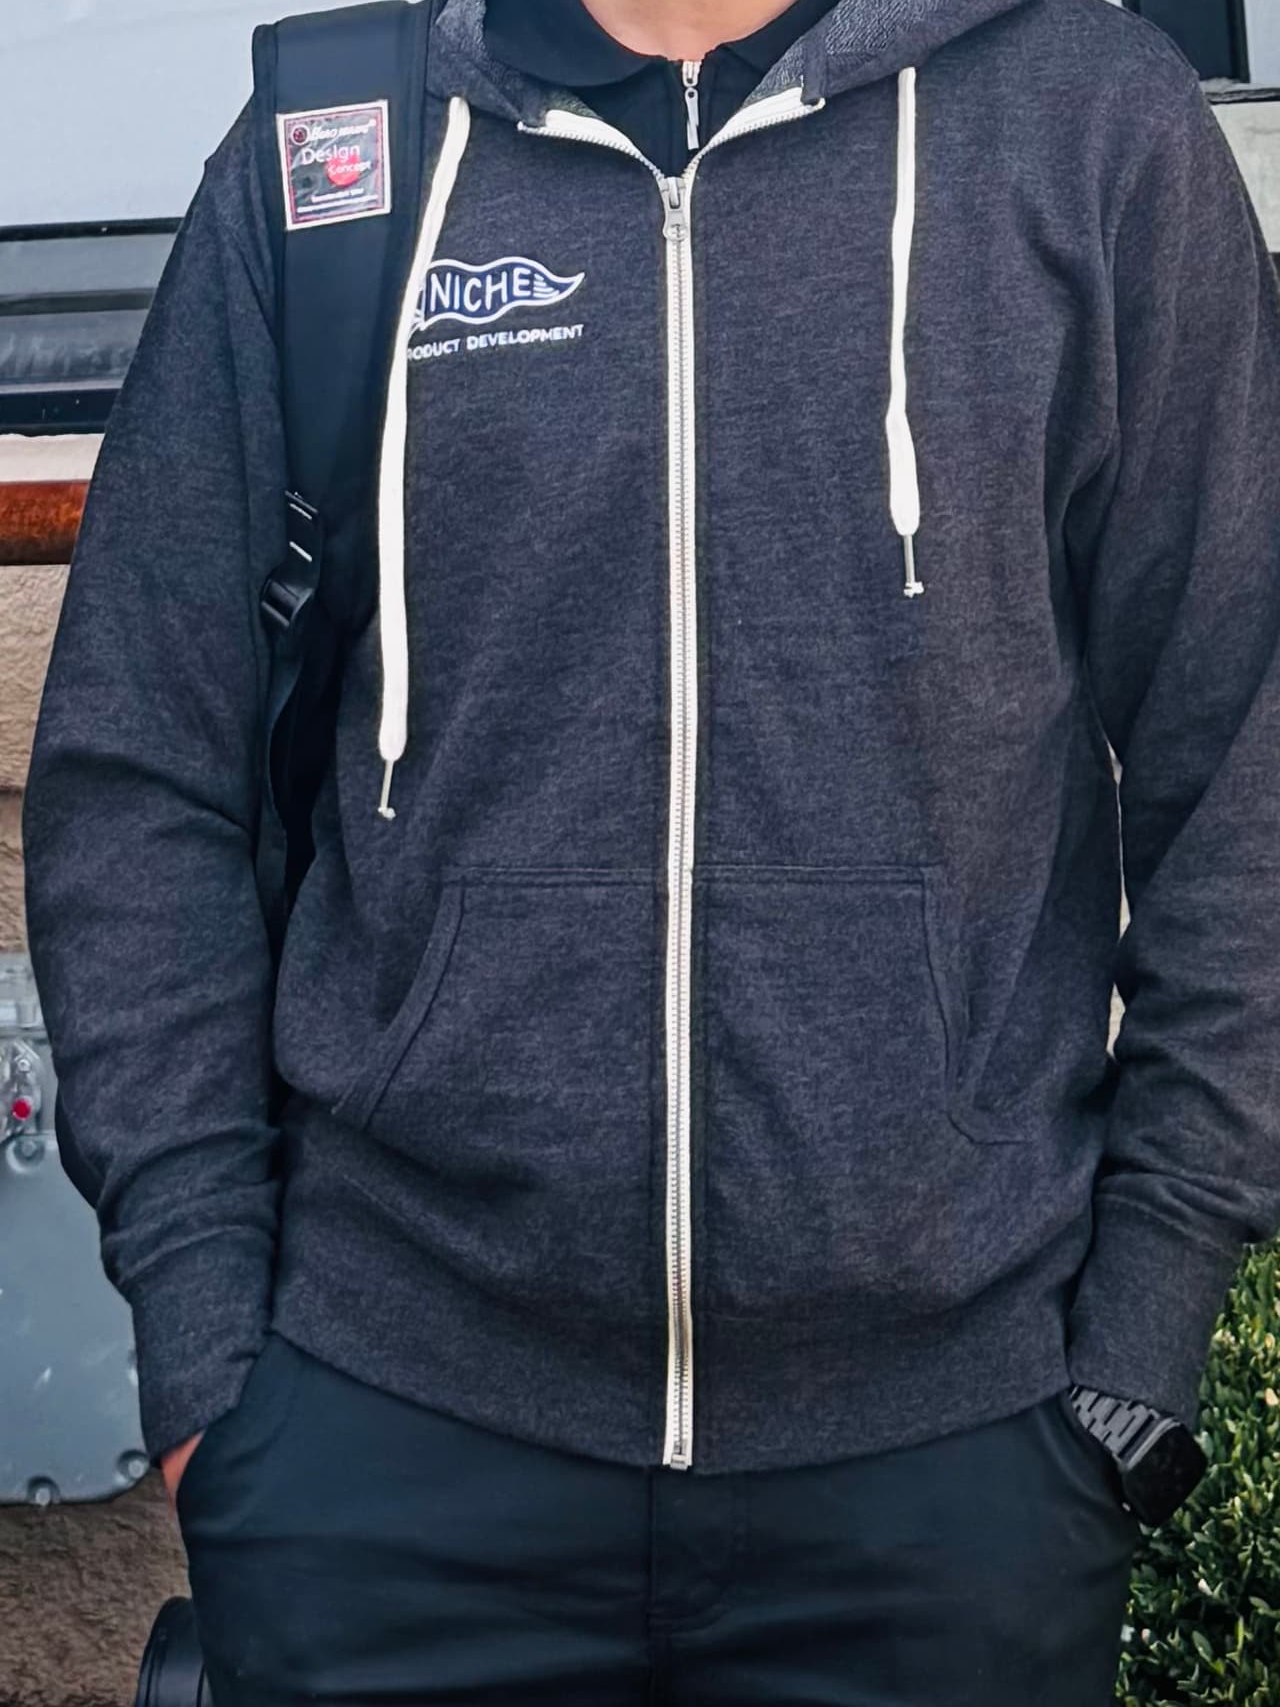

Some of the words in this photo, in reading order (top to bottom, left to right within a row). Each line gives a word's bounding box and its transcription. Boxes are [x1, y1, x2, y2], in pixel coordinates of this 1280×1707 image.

[301, 144, 360, 165] Design
[429, 266, 531, 313] NICHE
[407, 338, 461, 361] RODUCT
[466, 324, 584, 351] DEVELOPMENT
